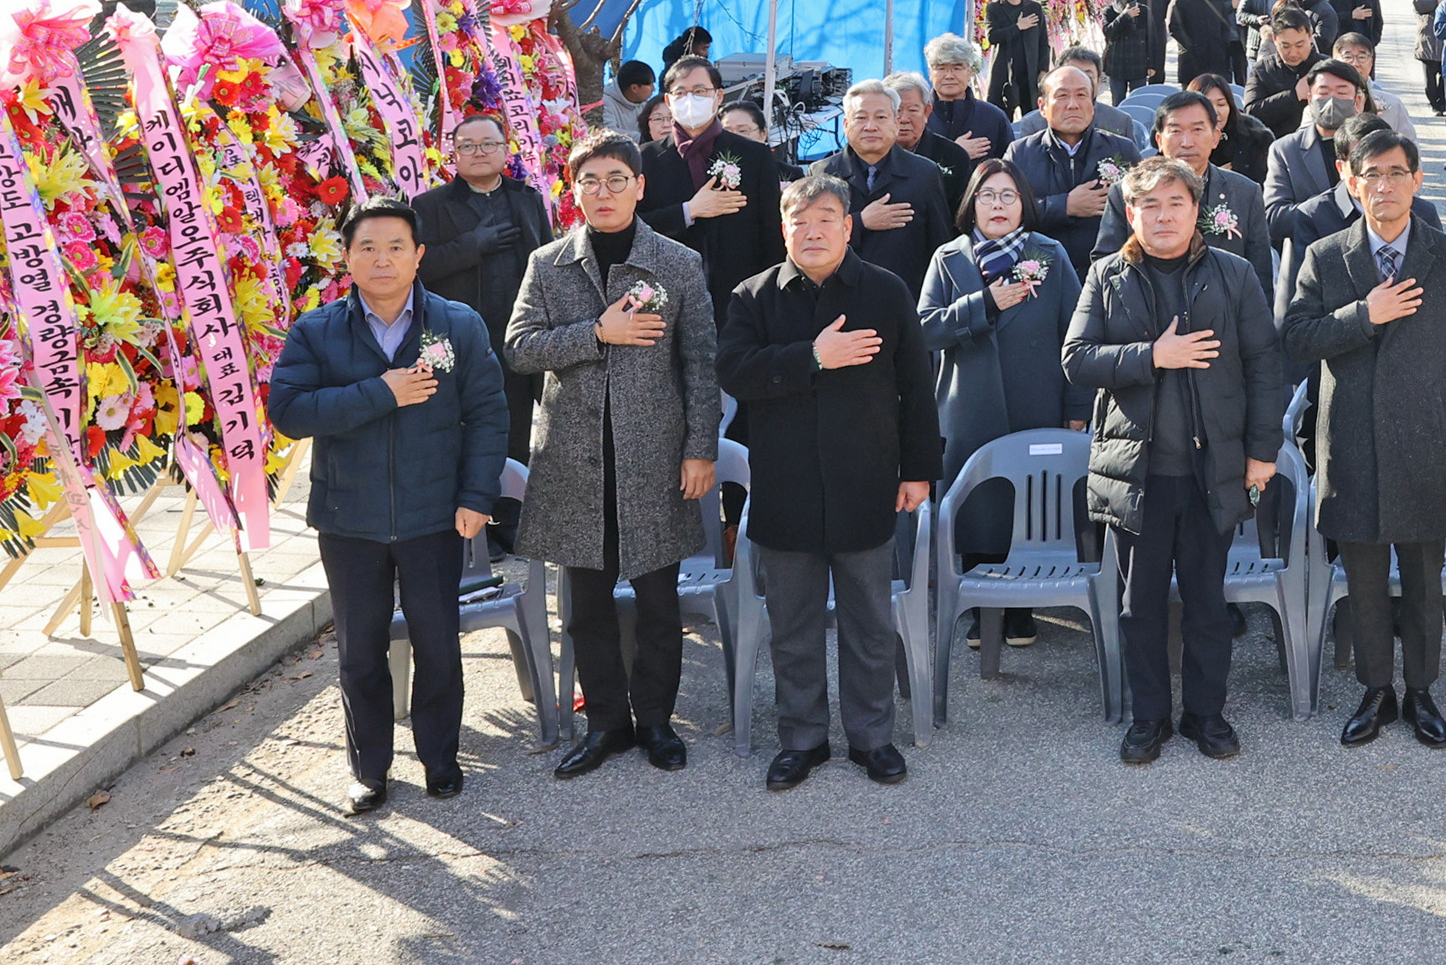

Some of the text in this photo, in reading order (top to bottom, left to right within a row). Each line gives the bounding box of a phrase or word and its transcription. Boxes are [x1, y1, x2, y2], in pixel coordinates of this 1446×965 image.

[145, 110, 236, 339] 케이디엠알오주식회사
[8, 223, 52, 292] 고방열
[32, 300, 78, 399] 경량금속
[212, 347, 240, 379] 대표
[219, 382, 254, 460] 김기덕
